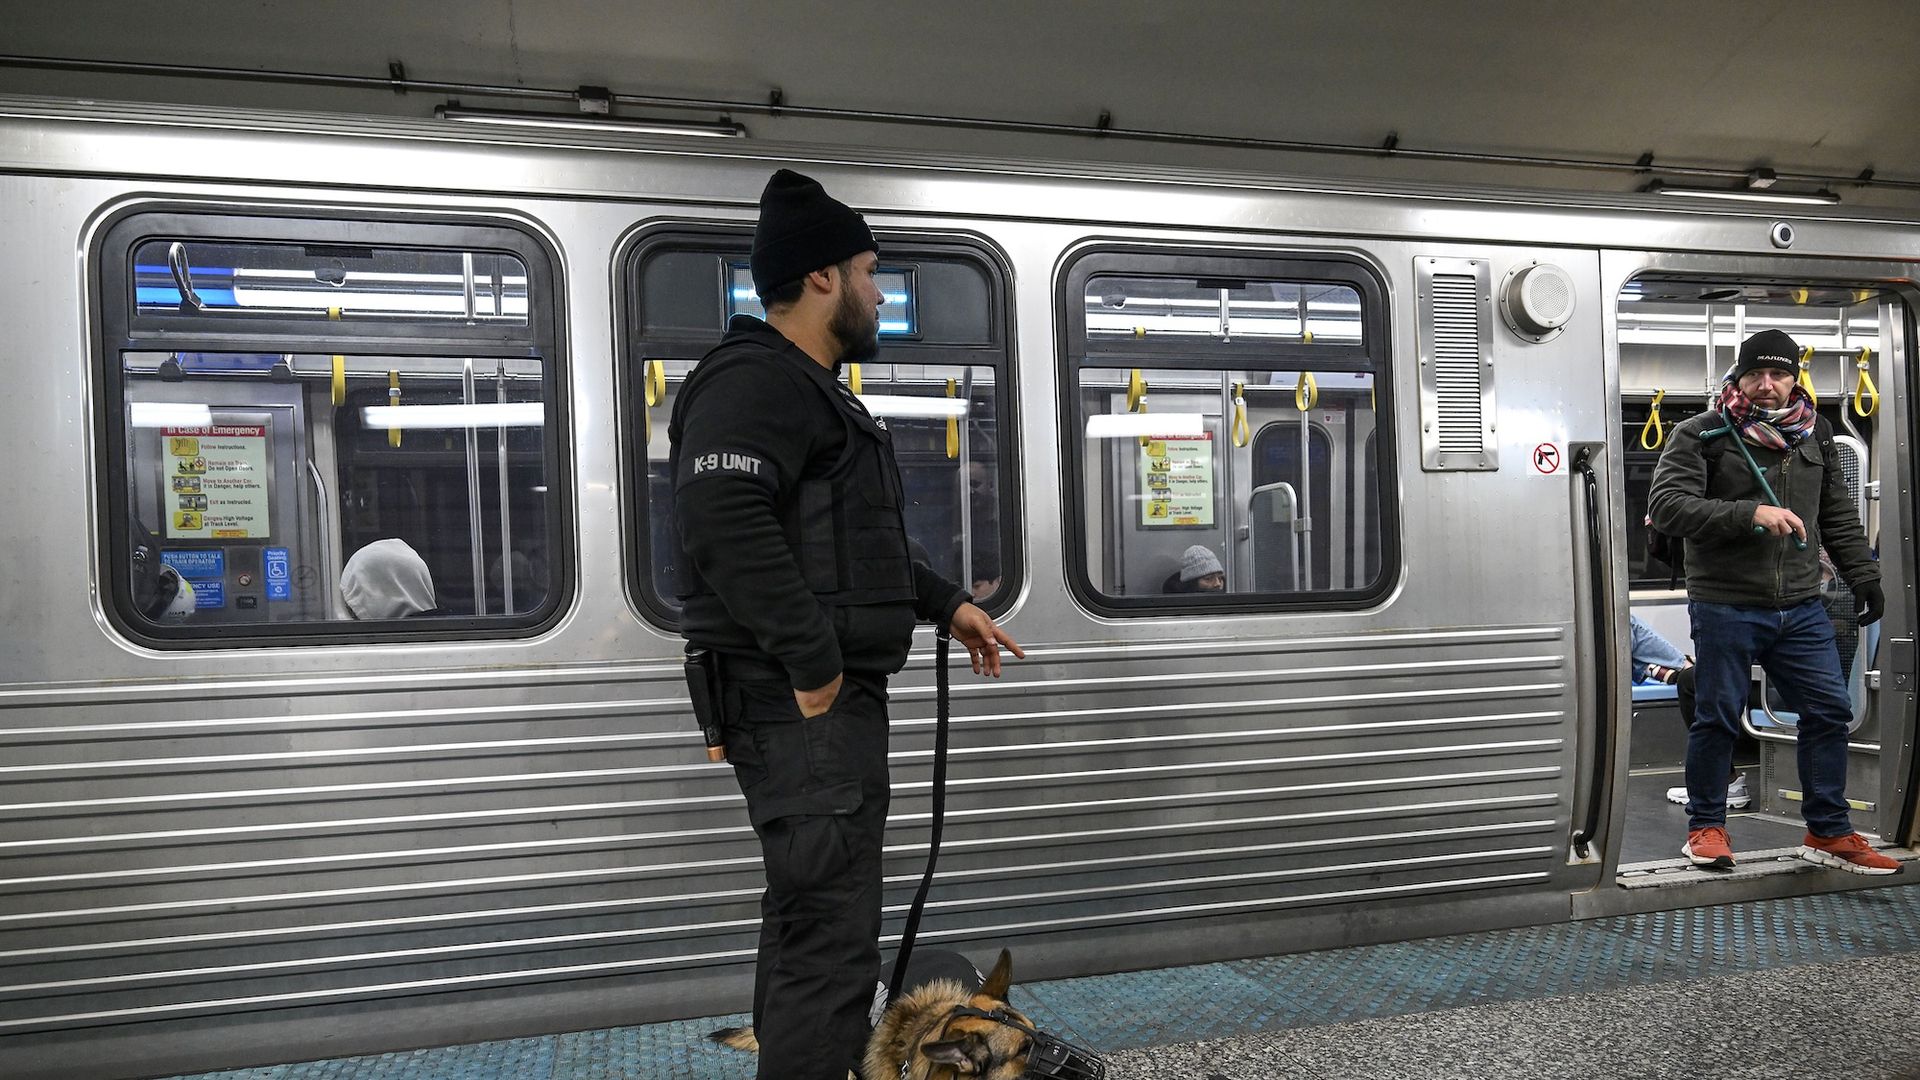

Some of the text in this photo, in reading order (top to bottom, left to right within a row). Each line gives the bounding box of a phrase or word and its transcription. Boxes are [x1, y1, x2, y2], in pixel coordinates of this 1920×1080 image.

[178, 426, 200, 434] Case
[201, 426, 210, 434] of
[212, 425, 260, 436] Emergency
[694, 452, 762, 475] K-9 UNIT
